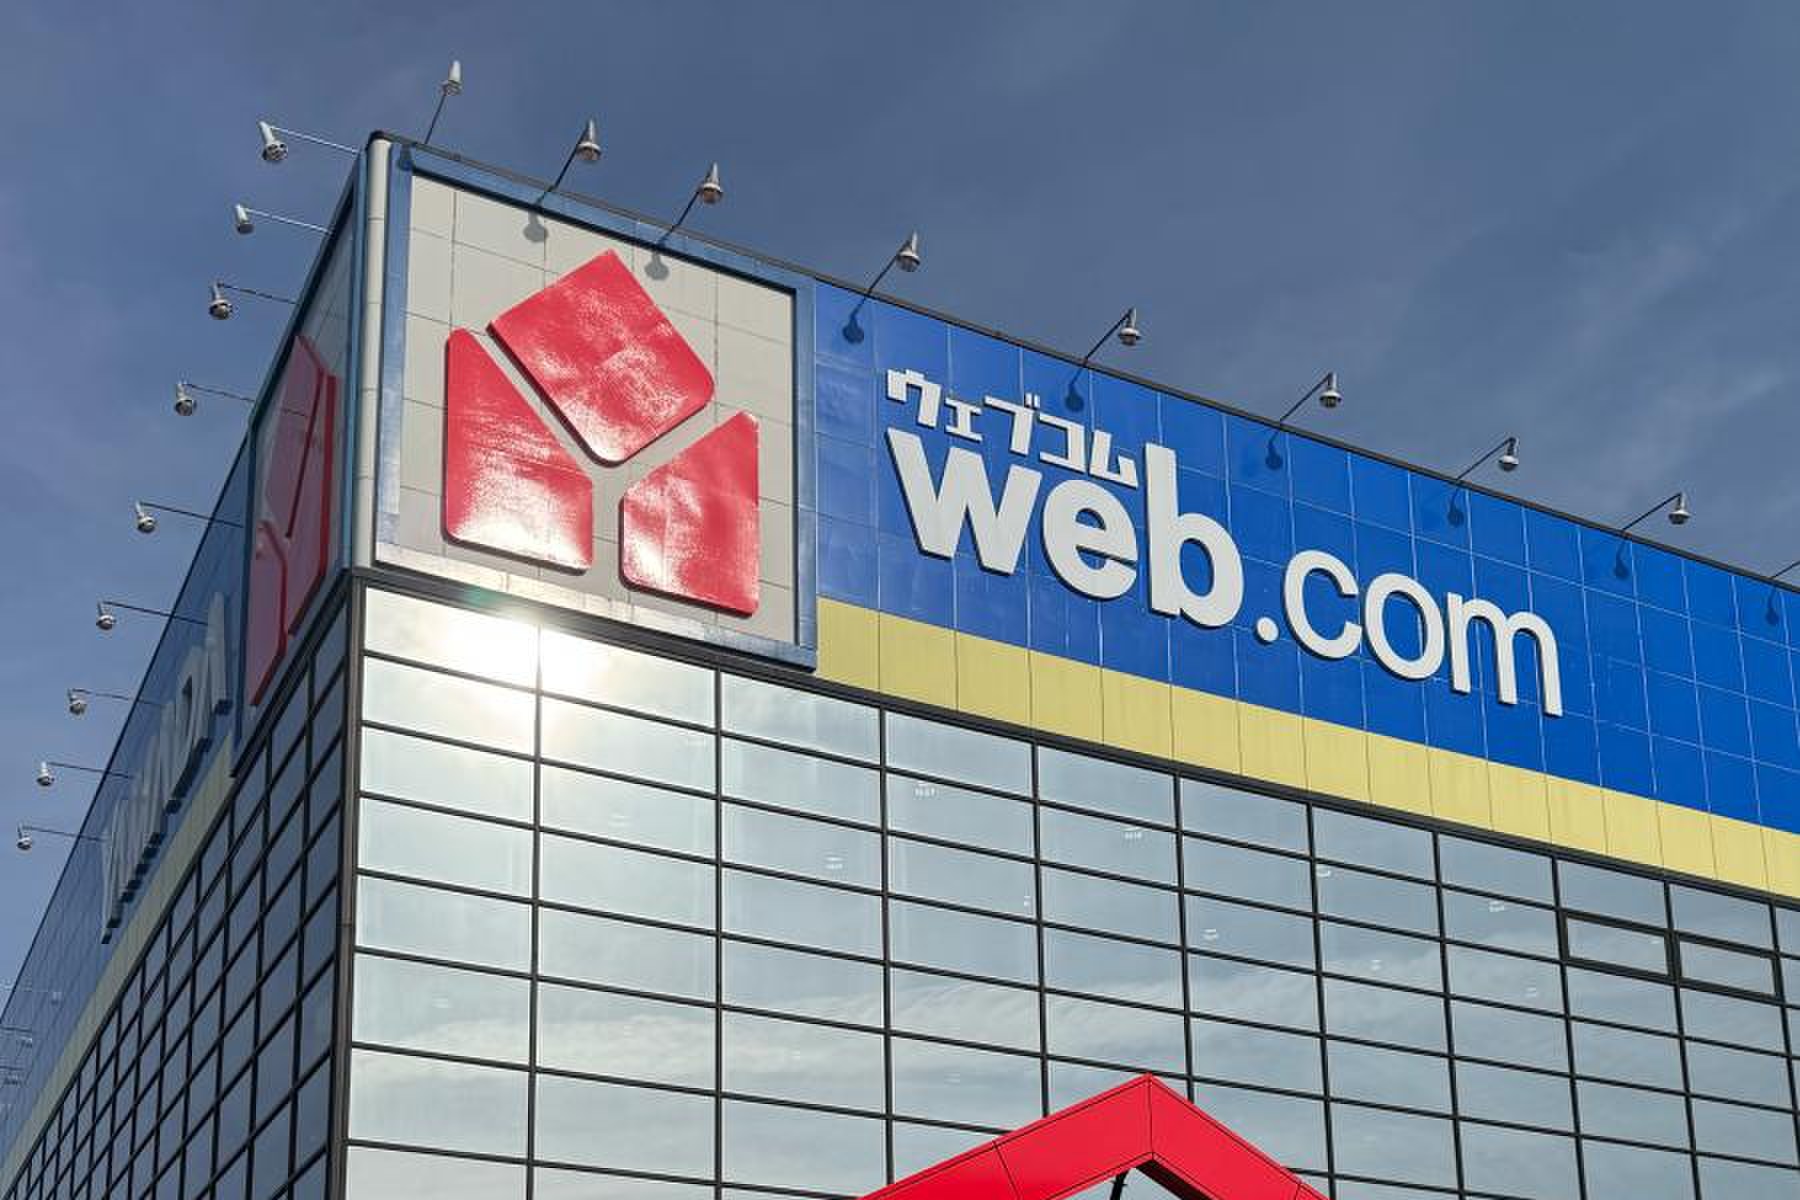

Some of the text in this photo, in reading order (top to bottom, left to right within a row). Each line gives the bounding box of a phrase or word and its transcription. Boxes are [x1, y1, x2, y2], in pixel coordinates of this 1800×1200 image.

[885, 368, 1139, 487] ウェブコム
[886, 427, 1563, 718] web.com
